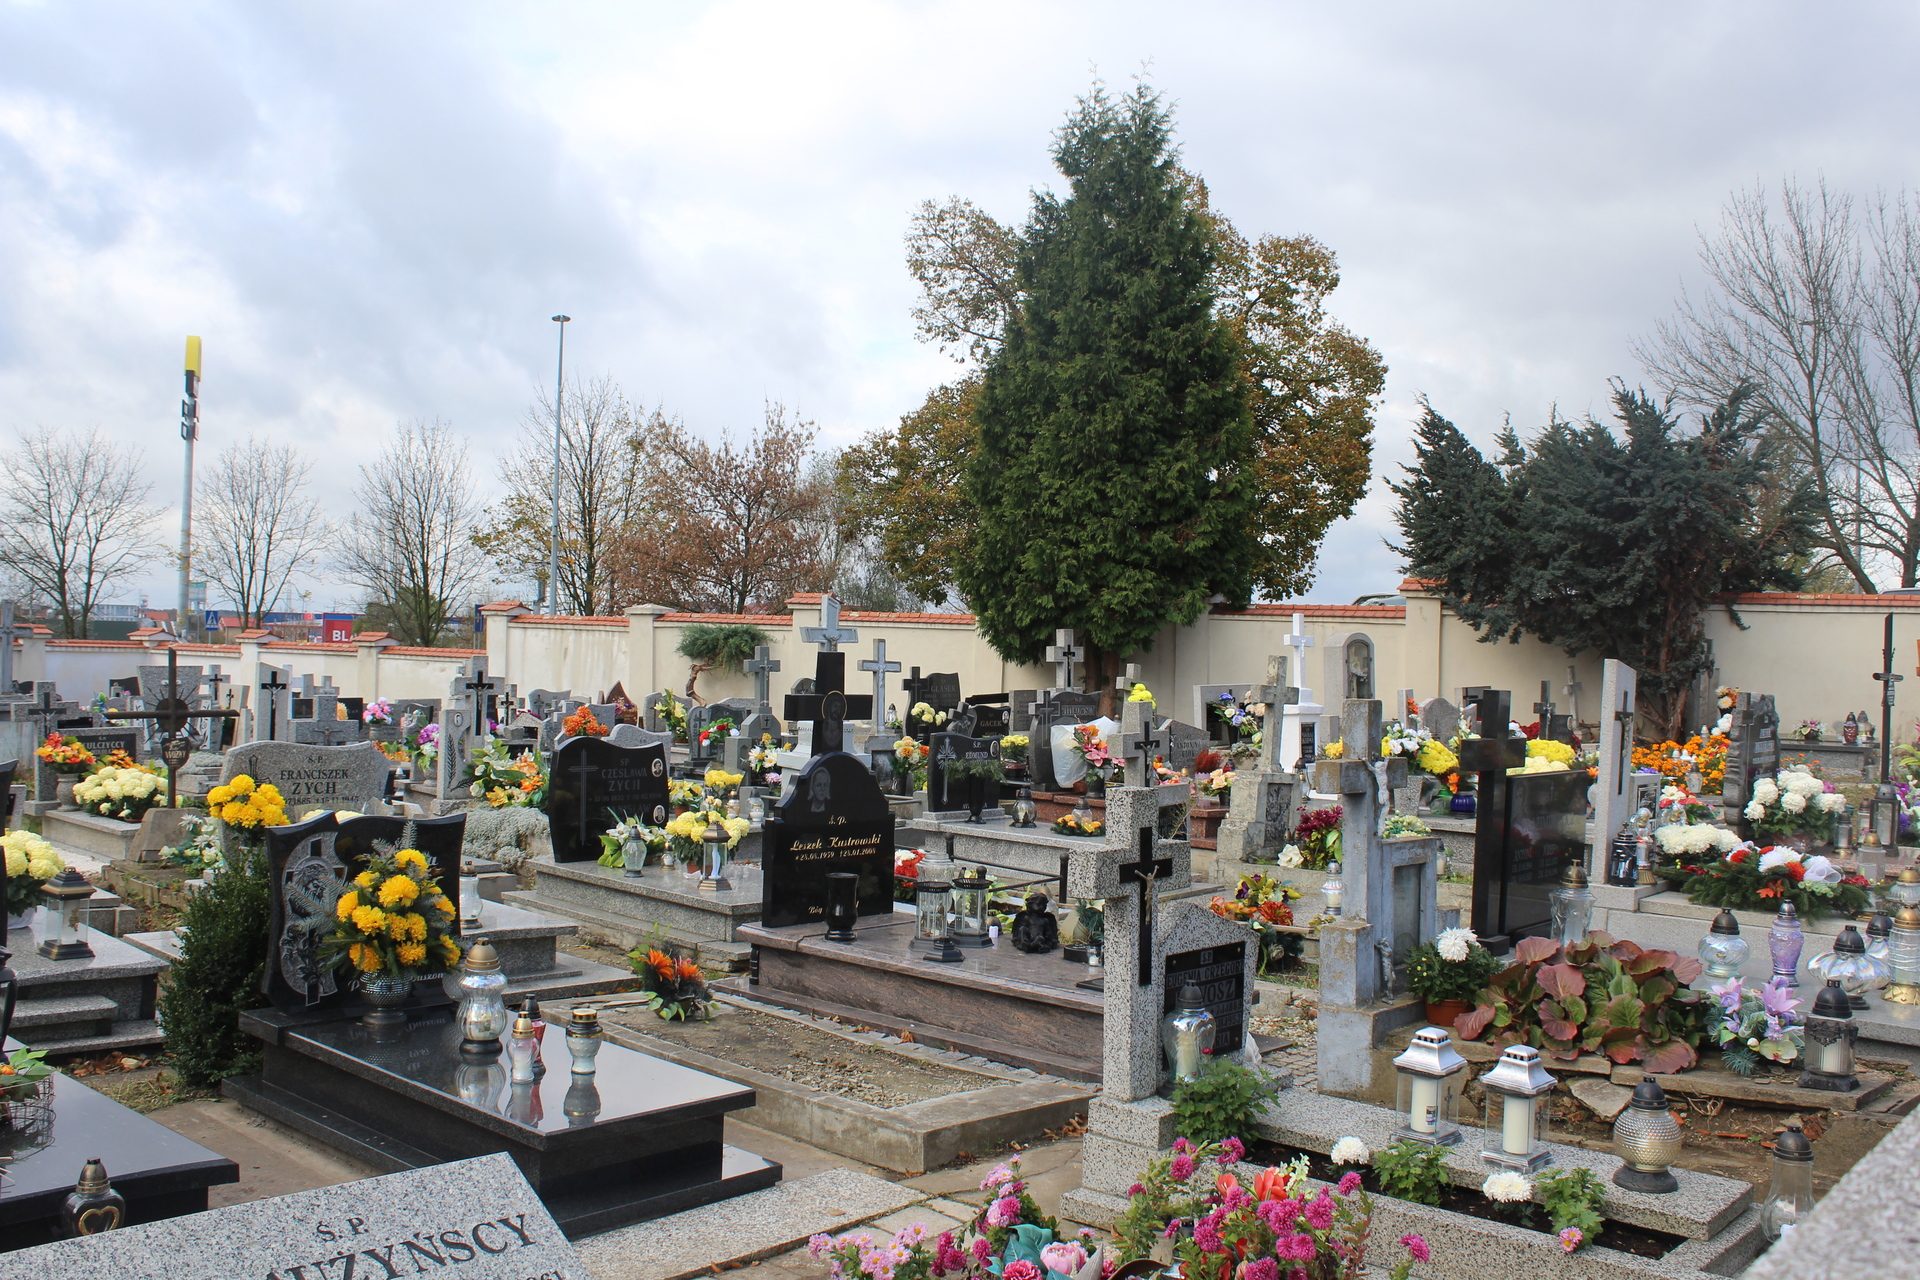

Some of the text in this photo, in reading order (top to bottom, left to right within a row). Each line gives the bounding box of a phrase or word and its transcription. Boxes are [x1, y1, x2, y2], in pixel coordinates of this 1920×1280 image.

[83, 740, 125, 750] ULCZYCCY
[965, 751, 989, 759] EDMUND
[280, 768, 350, 780] FRANCISZEK
[291, 781, 338, 796] ZYCH
[608, 779, 641, 792] ZYCH
[790, 833, 882, 851] Leszek Kustrowski
[1167, 970, 1201, 989] EUGENIA
